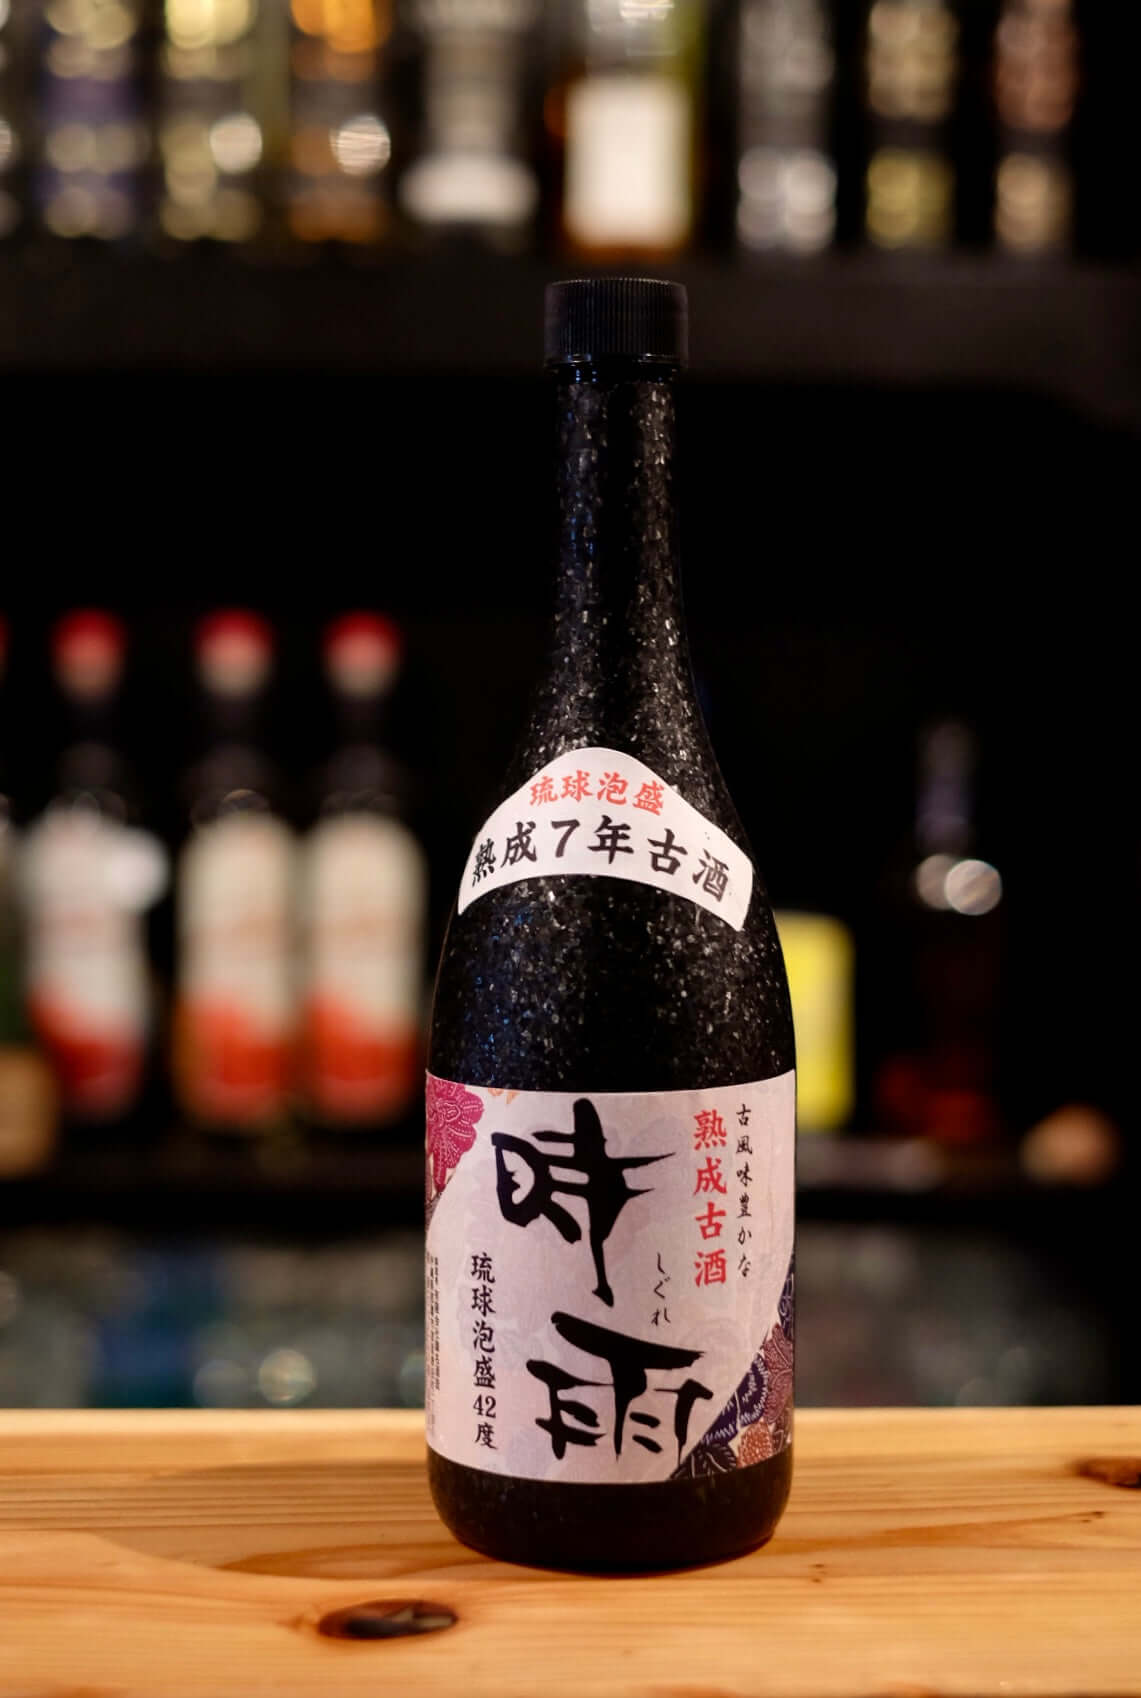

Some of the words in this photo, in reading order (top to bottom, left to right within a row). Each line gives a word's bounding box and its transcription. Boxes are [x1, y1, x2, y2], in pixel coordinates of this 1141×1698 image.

[471, 814, 731, 902] 熟成7年古酒
[529, 770, 665, 816] 琉球泡盛
[693, 1109, 727, 1287] 熟成古酒
[736, 1103, 753, 1278] 古風味豊かな
[471, 1251, 498, 1449] 琉球泡盛42度
[490, 1097, 714, 1465] 時雨
[651, 1252, 671, 1325] しぐれ
